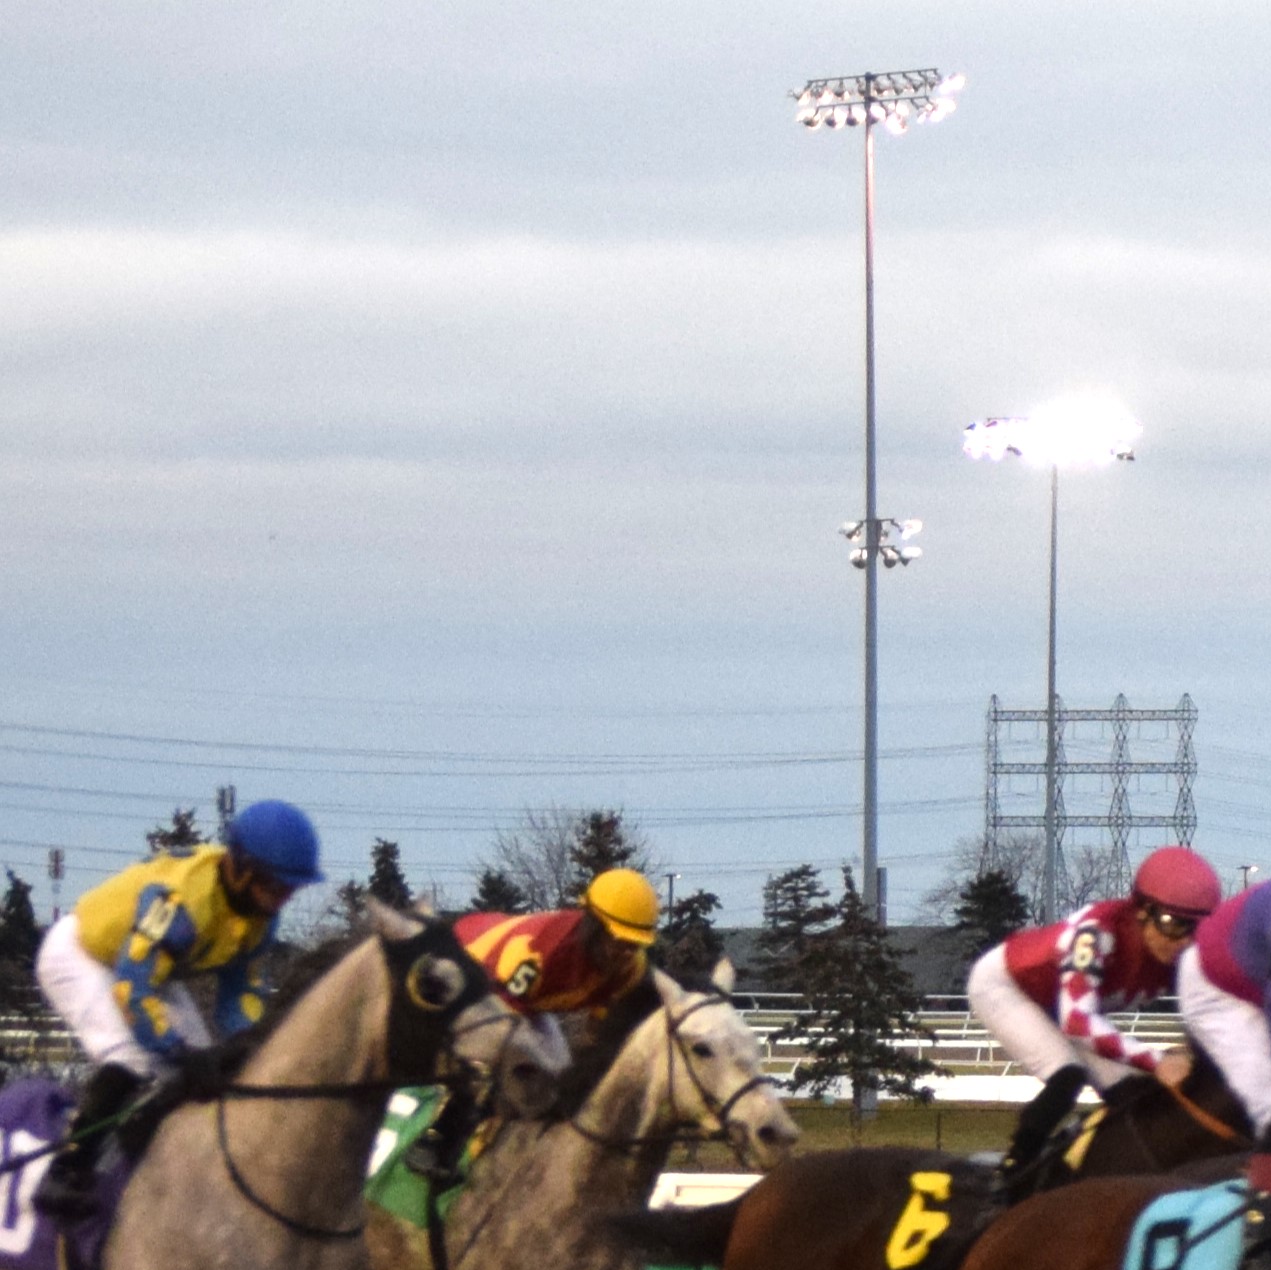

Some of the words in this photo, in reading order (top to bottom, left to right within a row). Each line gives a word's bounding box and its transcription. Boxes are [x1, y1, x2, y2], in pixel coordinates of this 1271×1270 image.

[1073, 932, 1096, 969] 6
[507, 964, 537, 996] 5
[886, 1171, 952, 1270] 6
